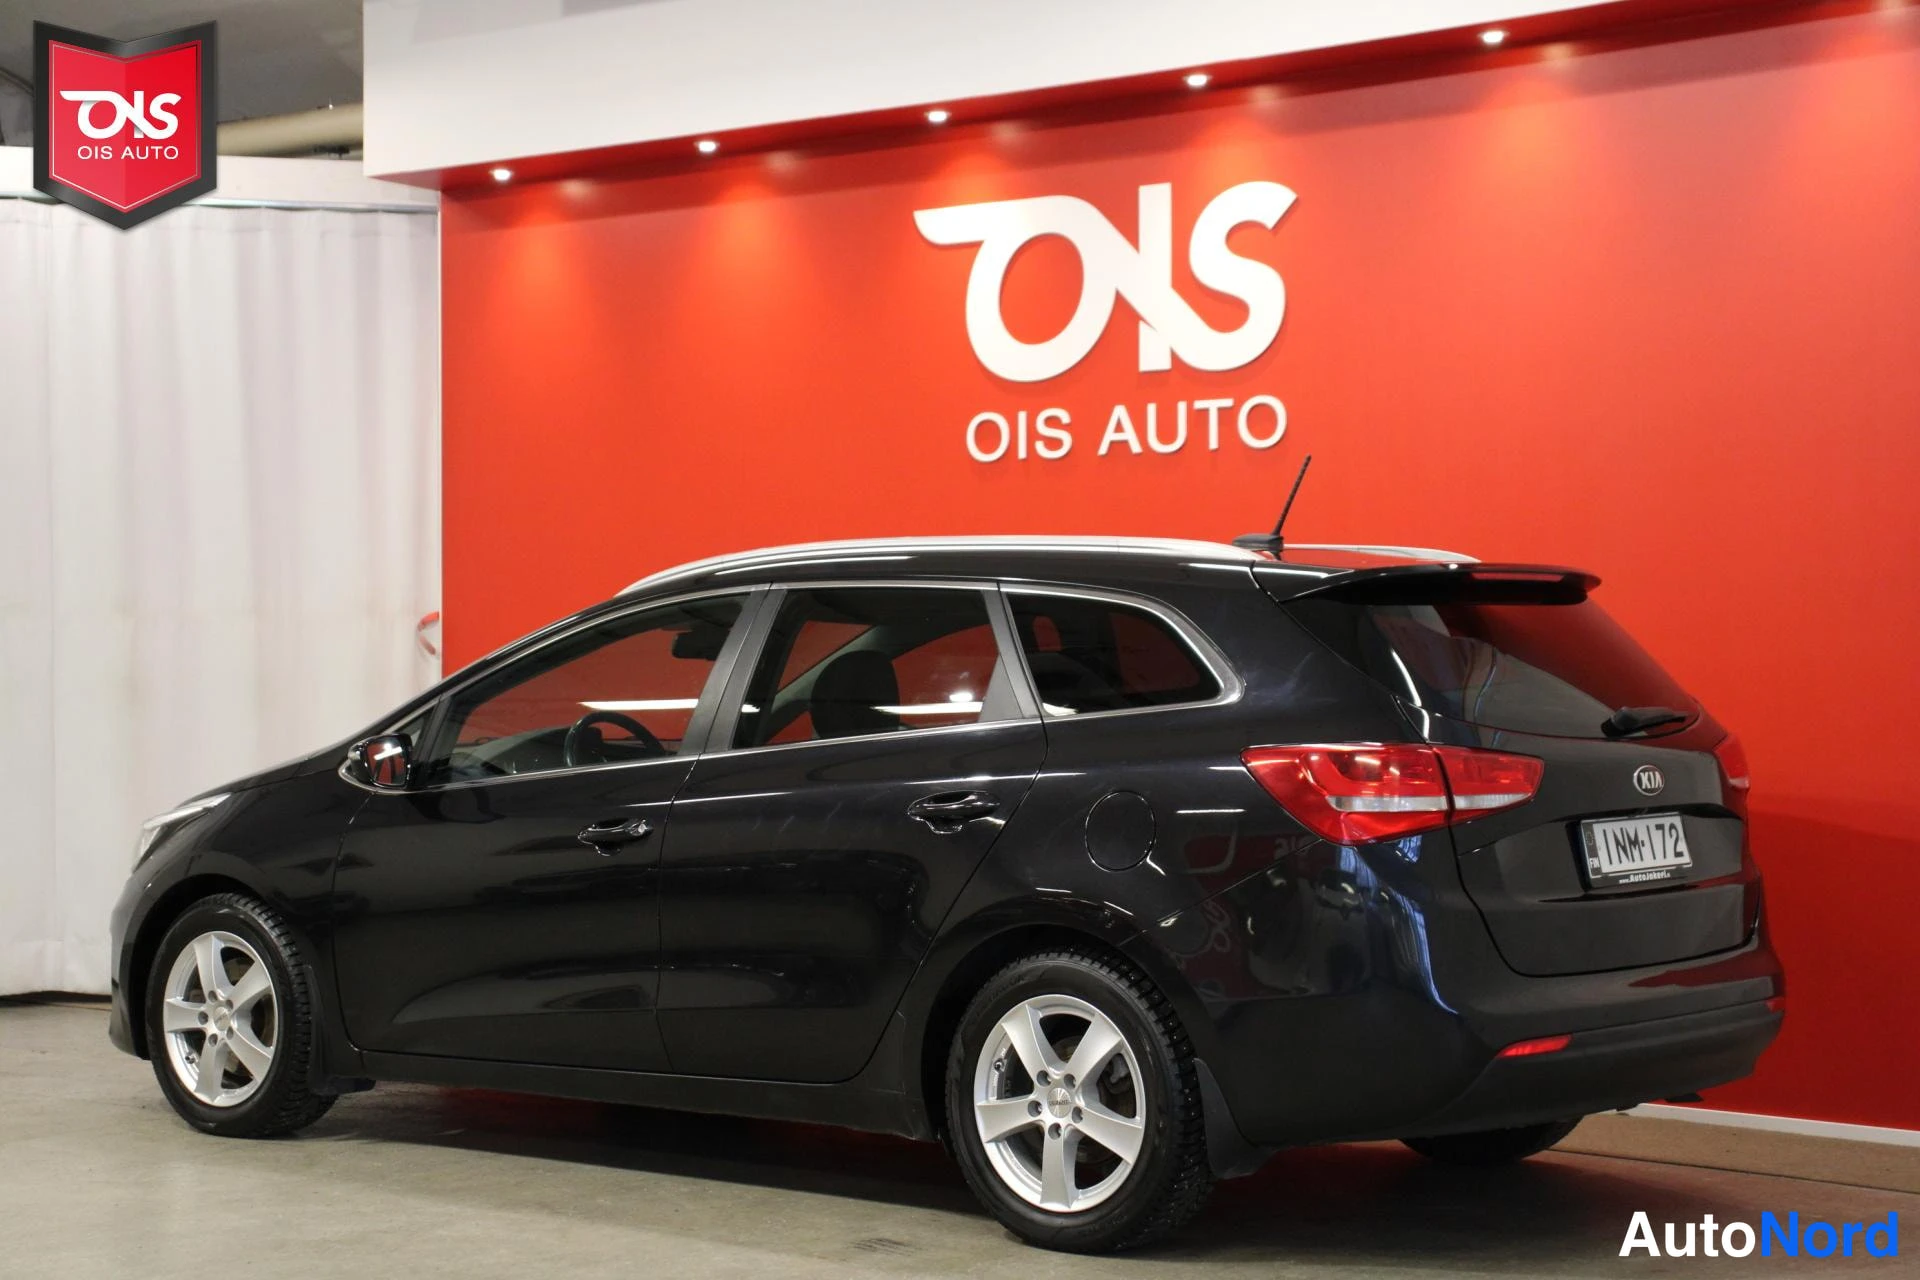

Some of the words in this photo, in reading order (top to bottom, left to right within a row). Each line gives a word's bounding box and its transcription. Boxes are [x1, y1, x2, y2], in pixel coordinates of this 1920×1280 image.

[965, 407, 1073, 463] OIS
[1097, 394, 1288, 457] AUTO
[1639, 771, 1663, 790] KIA
[1602, 822, 1685, 866] INM-172
